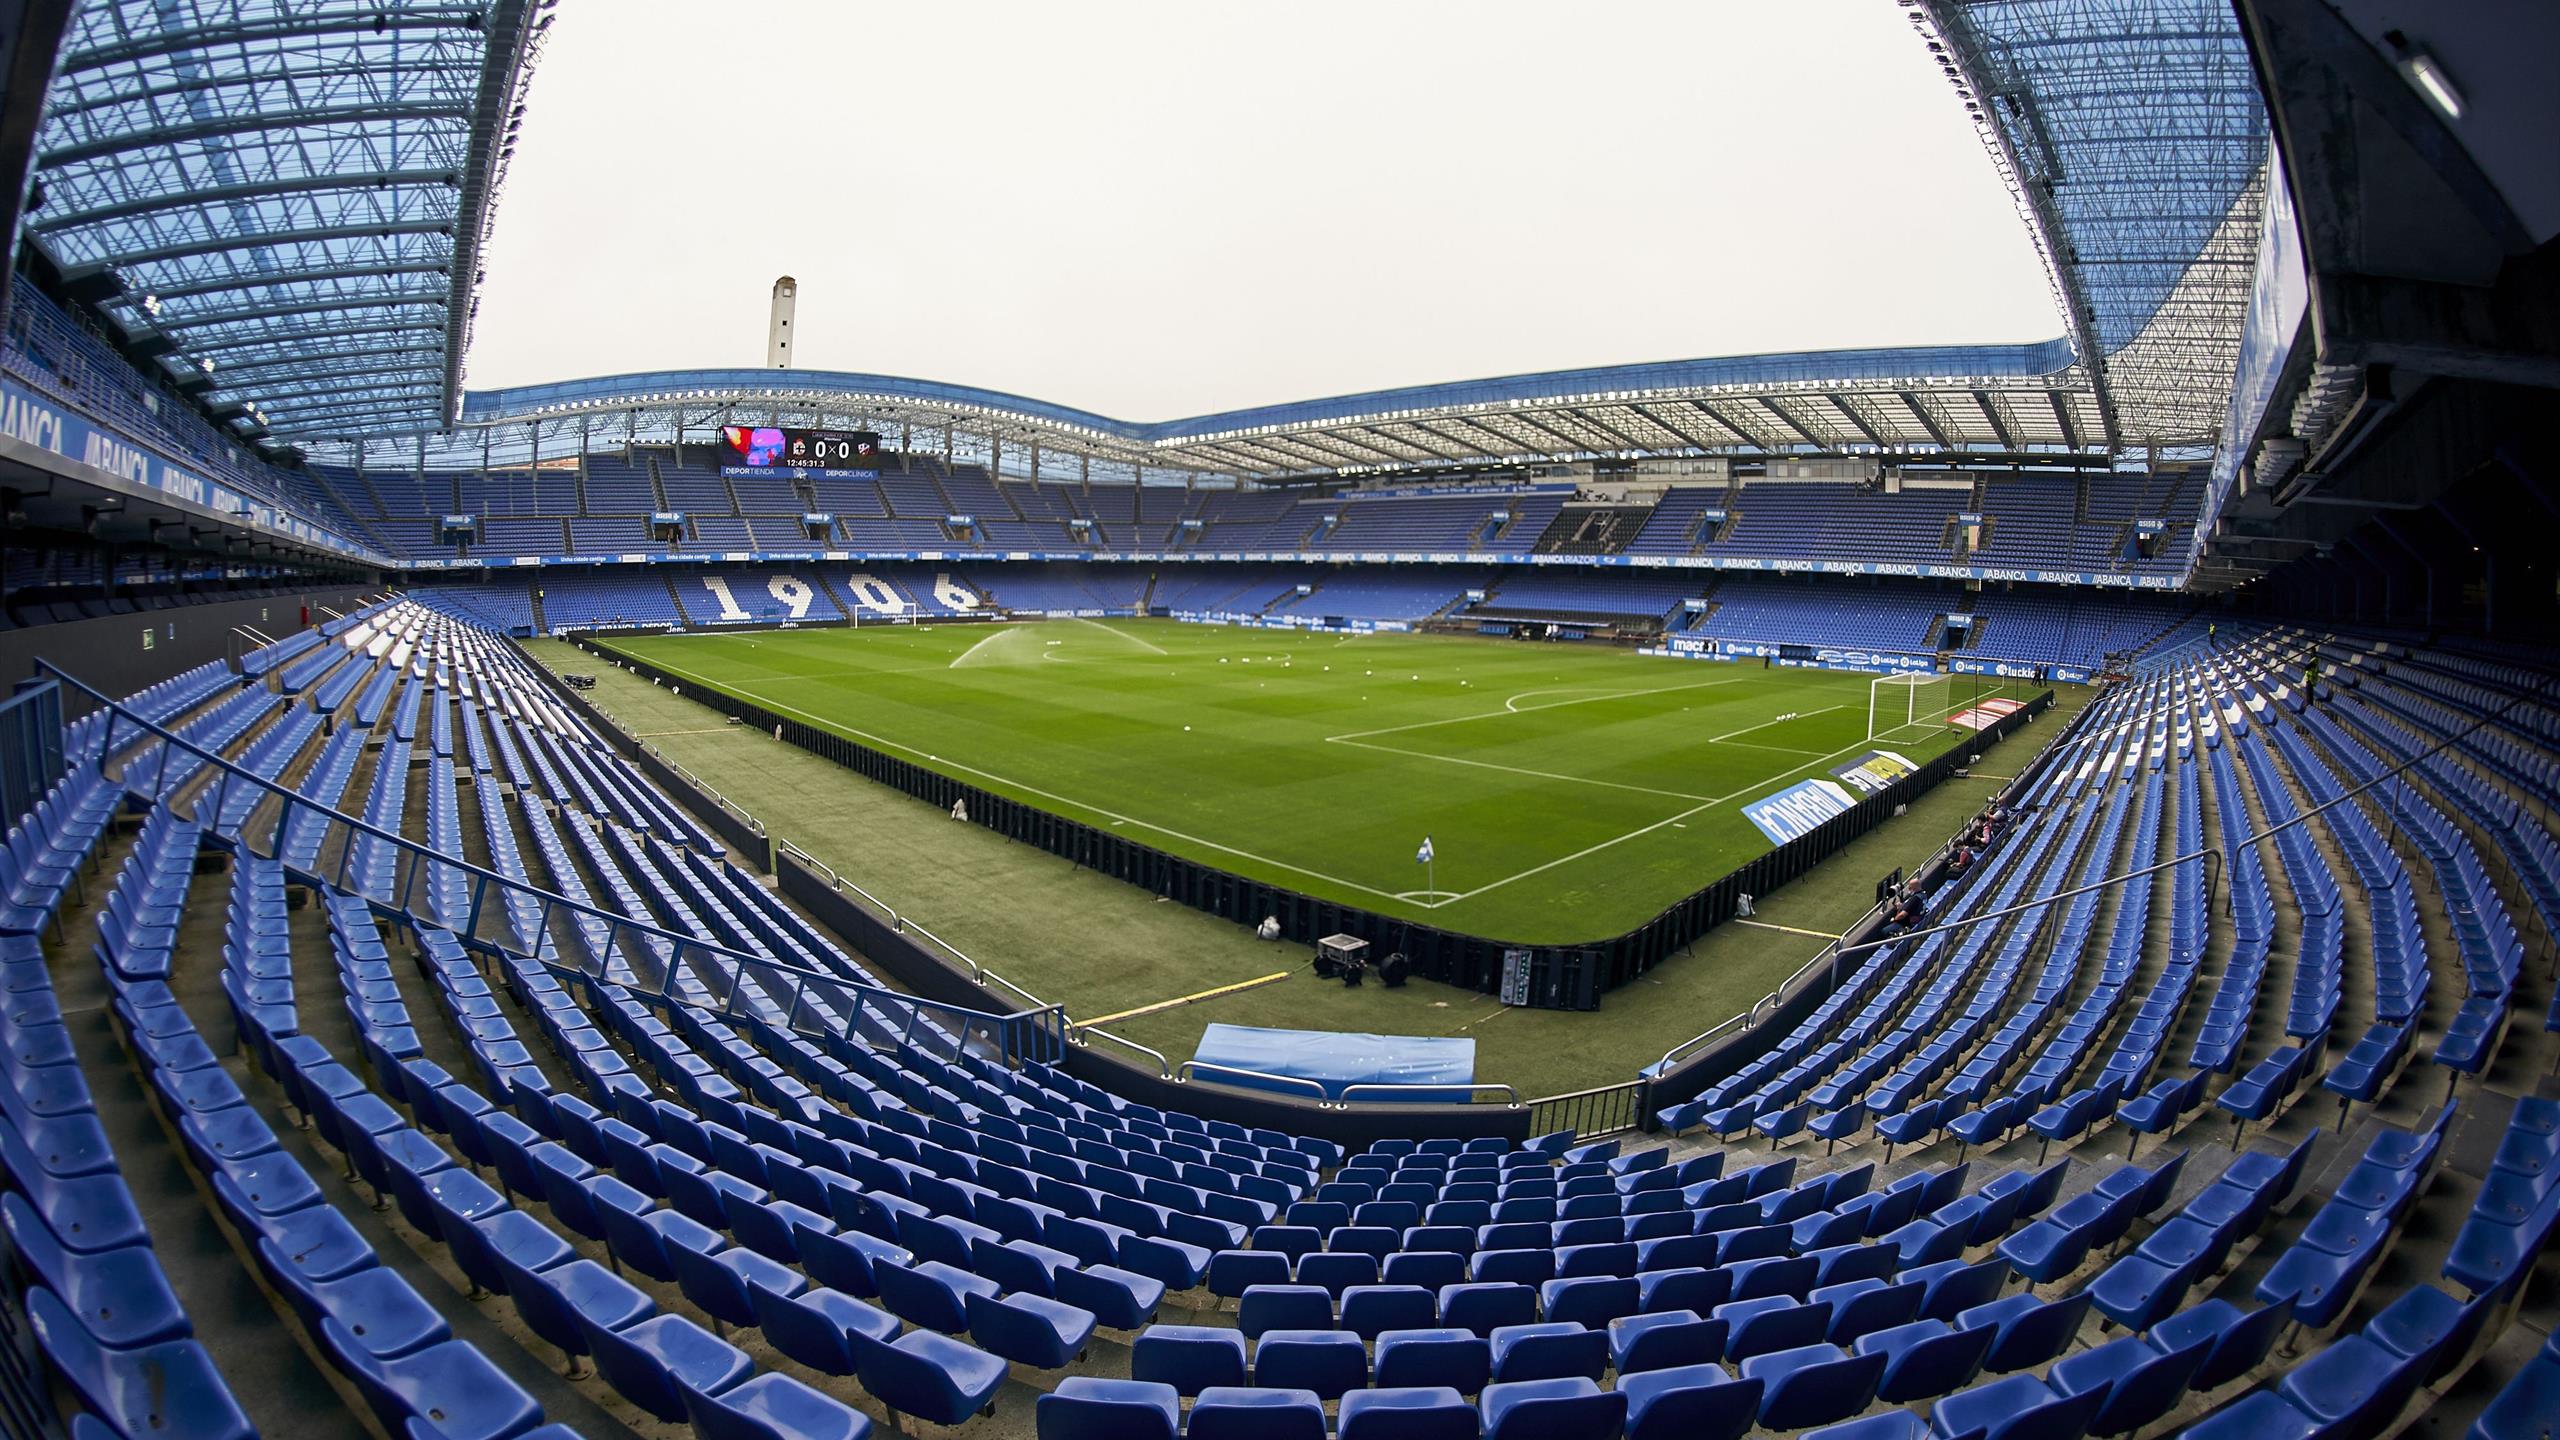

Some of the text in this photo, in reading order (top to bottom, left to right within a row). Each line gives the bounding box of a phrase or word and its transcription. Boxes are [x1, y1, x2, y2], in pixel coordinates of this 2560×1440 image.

[0, 388, 62, 455] ANCA
[815, 441, 826, 458] 0
[838, 442, 849, 459] 0
[84, 431, 148, 485] ABANCA
[786, 459, 825, 468] 12:45:31.3
[2138, 520, 2155, 528] asisa
[450, 558, 483, 567] ABANCA
[1565, 555, 1597, 564] RIAZOR
[1630, 556, 1668, 566] ABANCA
[1675, 557, 1714, 568] ABANCA
[1723, 558, 1762, 568] ABANCA
[1772, 560, 1813, 570] ABANCA
[1823, 561, 1864, 572] ABANCA
[1875, 564, 1918, 575] ABANCA
[1928, 566, 1972, 577] ABANCA
[1983, 569, 2027, 580] ABANCA
[2038, 572, 2082, 584] ABANCA
[2092, 574, 2132, 586] ABANCA
[2139, 576, 2166, 587] ABANCA
